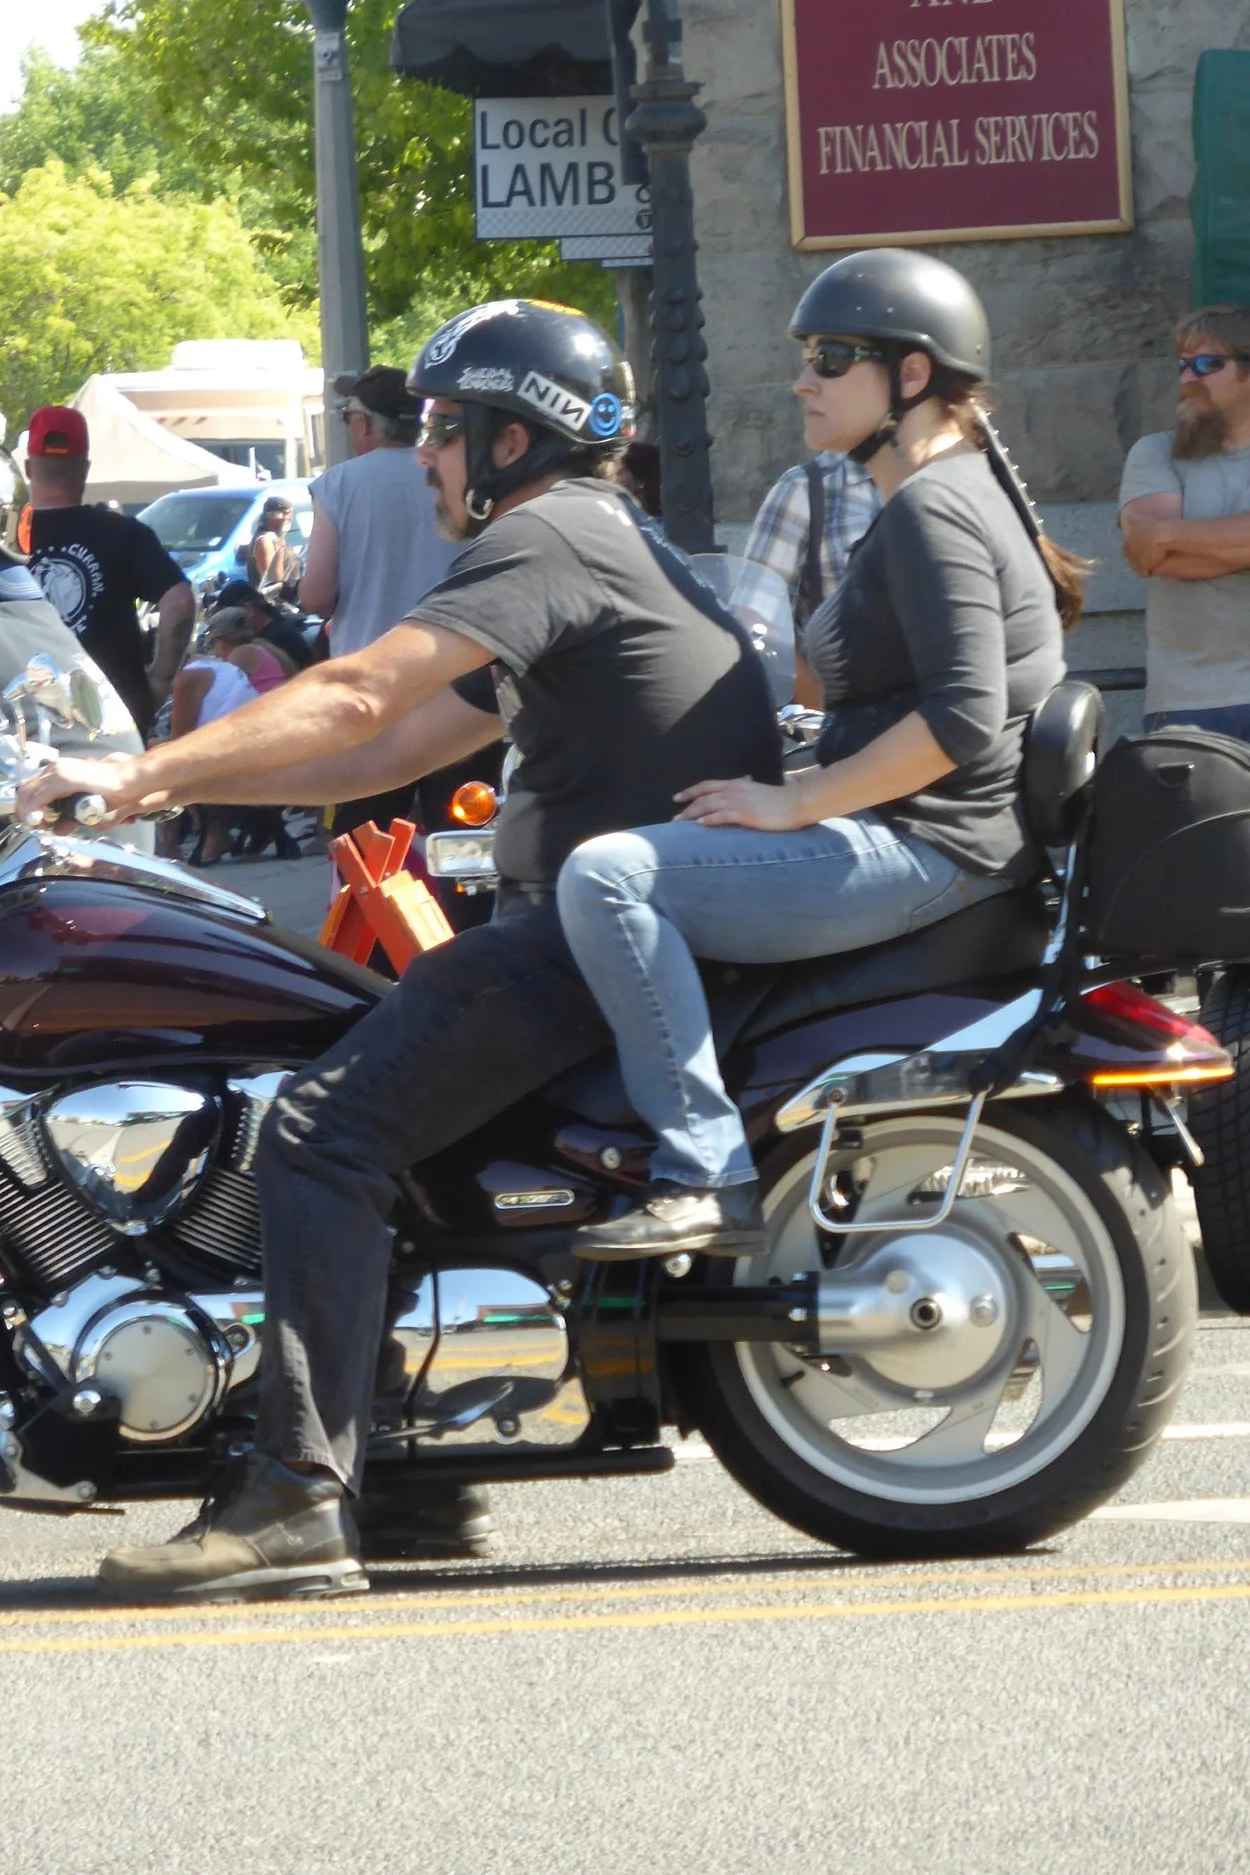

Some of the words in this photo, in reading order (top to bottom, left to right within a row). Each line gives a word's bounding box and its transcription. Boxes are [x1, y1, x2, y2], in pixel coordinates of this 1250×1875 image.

[872, 32, 1038, 90] ASSOCIATES
[480, 108, 587, 150] Local
[817, 119, 969, 175] FINANCIAL
[975, 110, 1100, 166] SERVICES
[481, 161, 616, 208] LAMB
[524, 377, 586, 423] NIN
